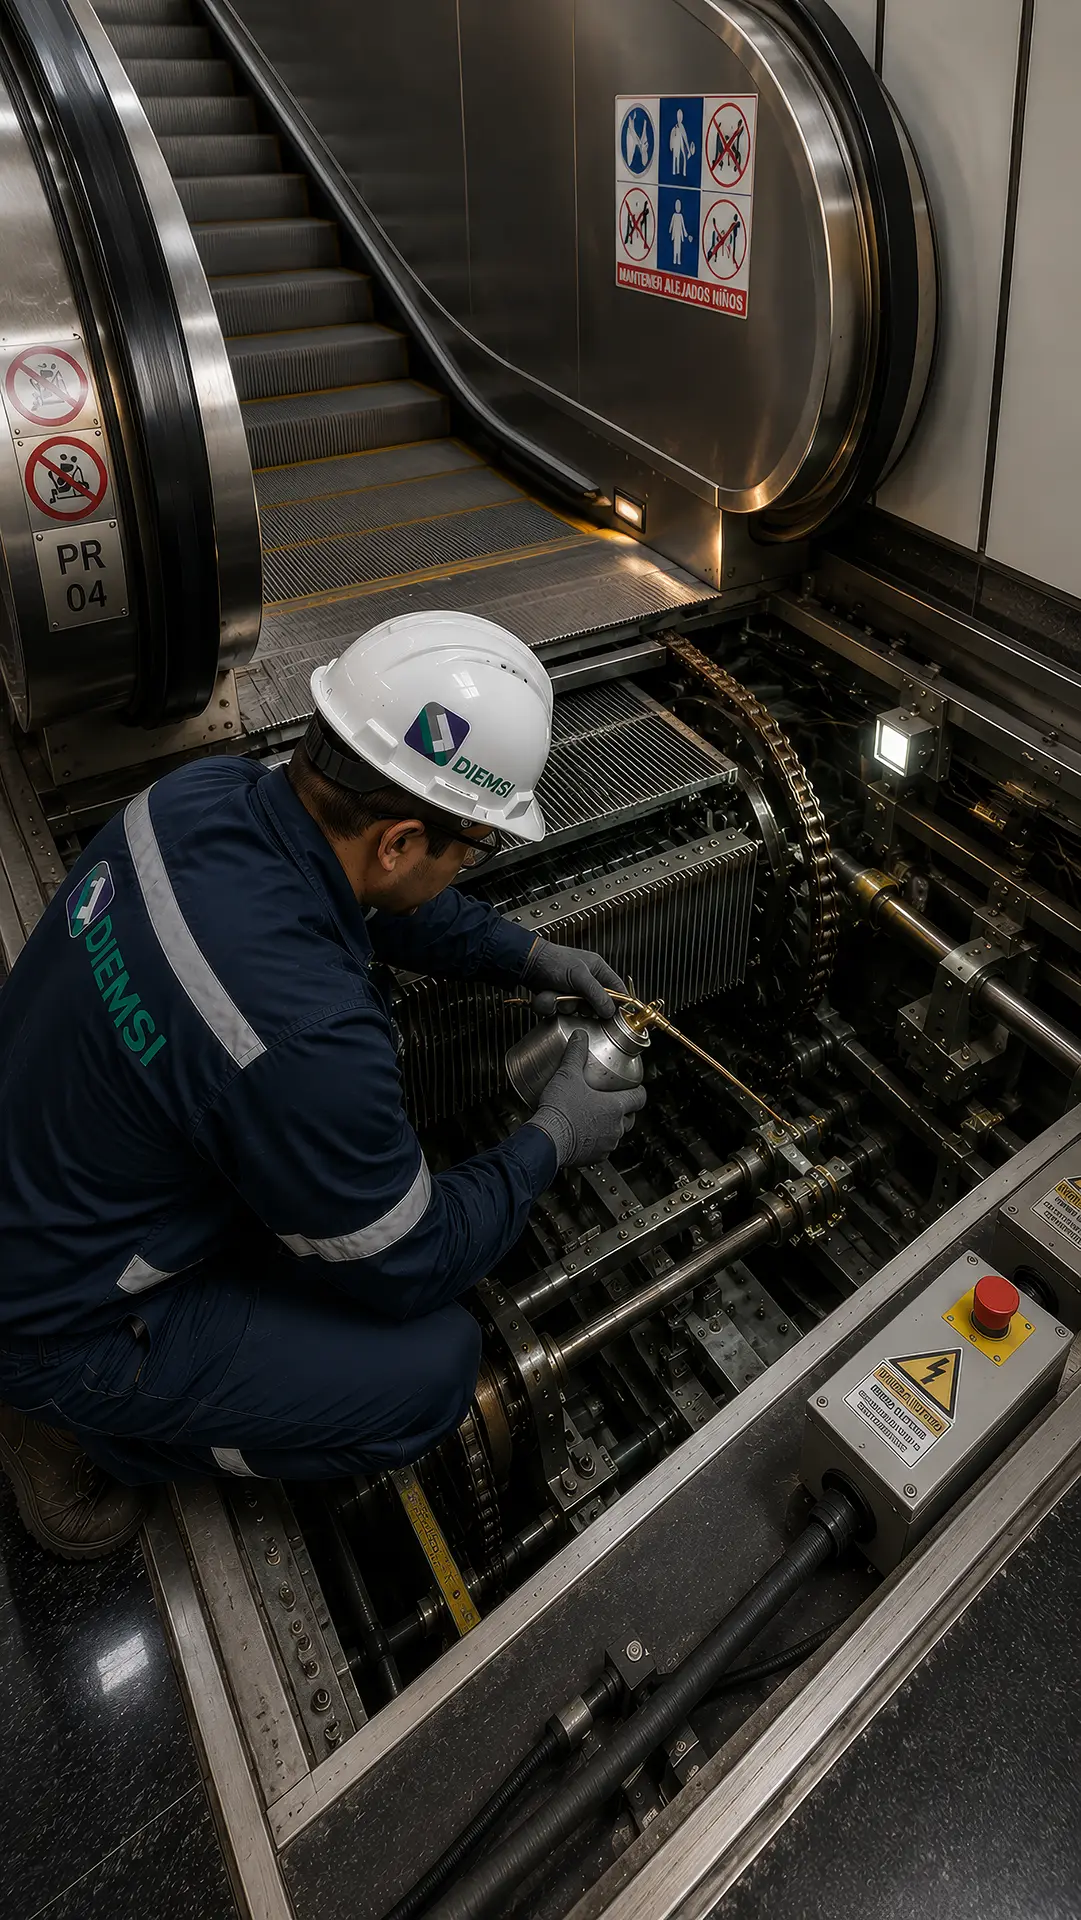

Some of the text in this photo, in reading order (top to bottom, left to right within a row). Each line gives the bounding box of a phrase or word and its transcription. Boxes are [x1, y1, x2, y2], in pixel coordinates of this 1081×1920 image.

[664, 279, 710, 303] ALEJADOS
[57, 540, 106, 575] PR
[66, 580, 107, 612] 04
[452, 756, 515, 798] DIEMSI
[85, 915, 167, 1067] DIEMSI
